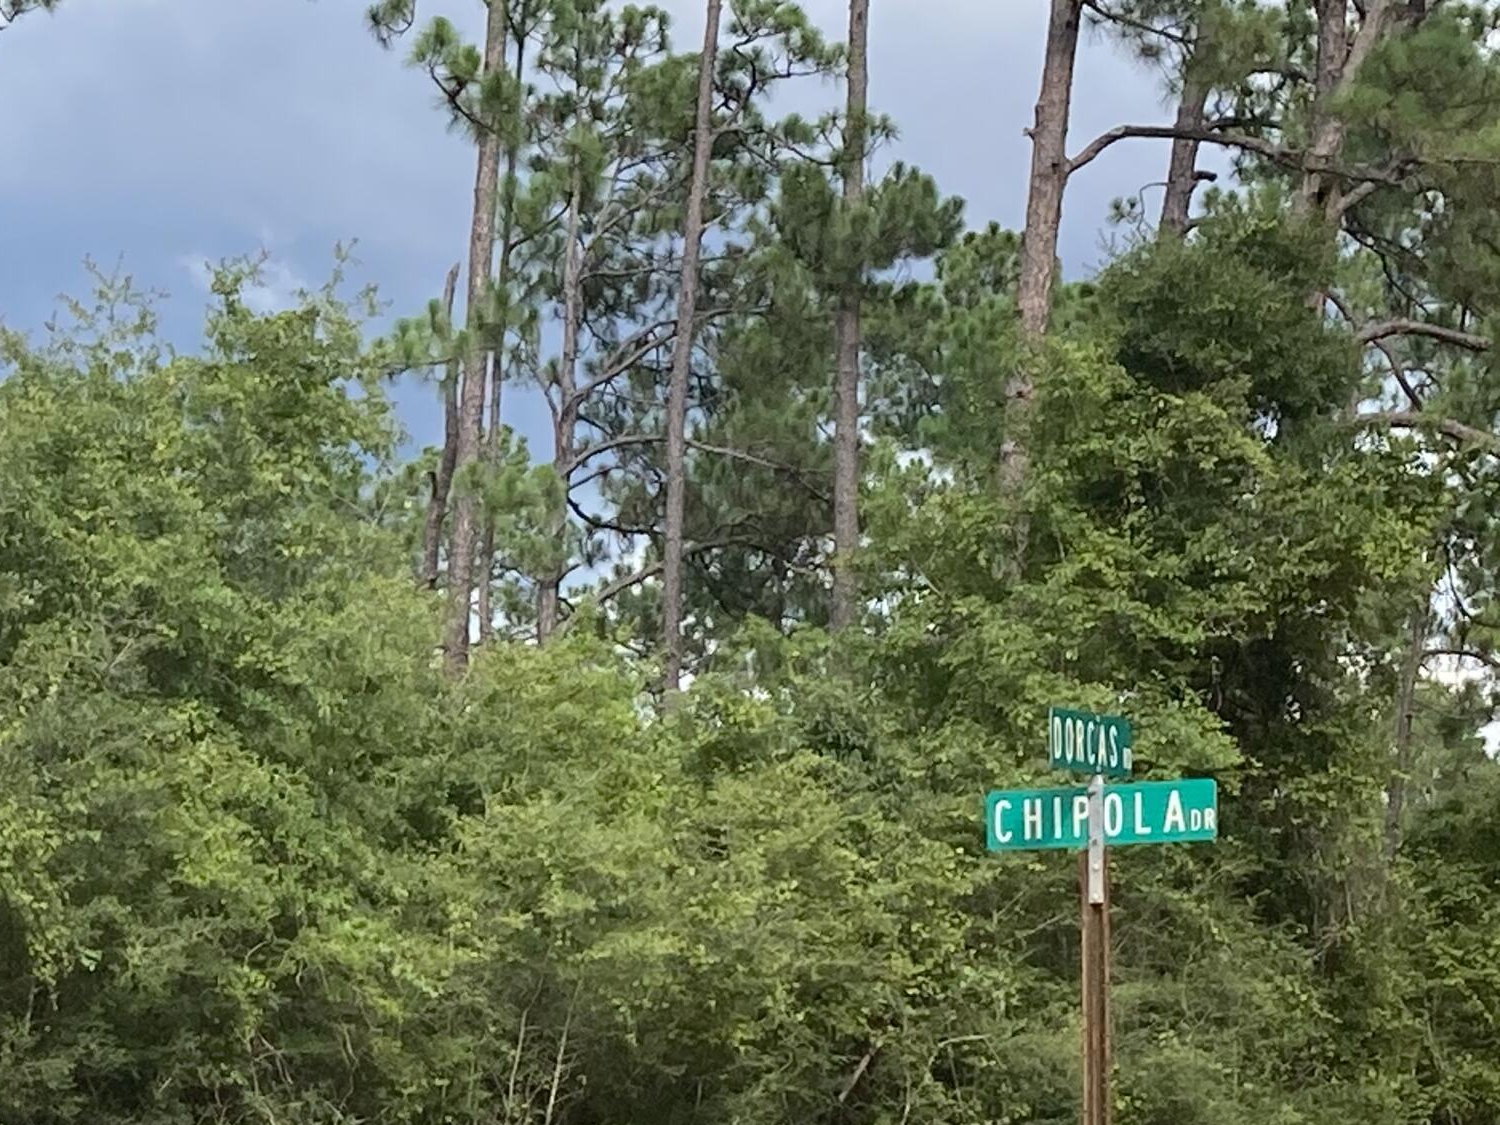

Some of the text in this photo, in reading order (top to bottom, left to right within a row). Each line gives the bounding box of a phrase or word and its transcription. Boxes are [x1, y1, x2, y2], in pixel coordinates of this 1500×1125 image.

[1053, 716, 1118, 768] DORCAS
[995, 790, 1216, 842] CHIPOLA DR
